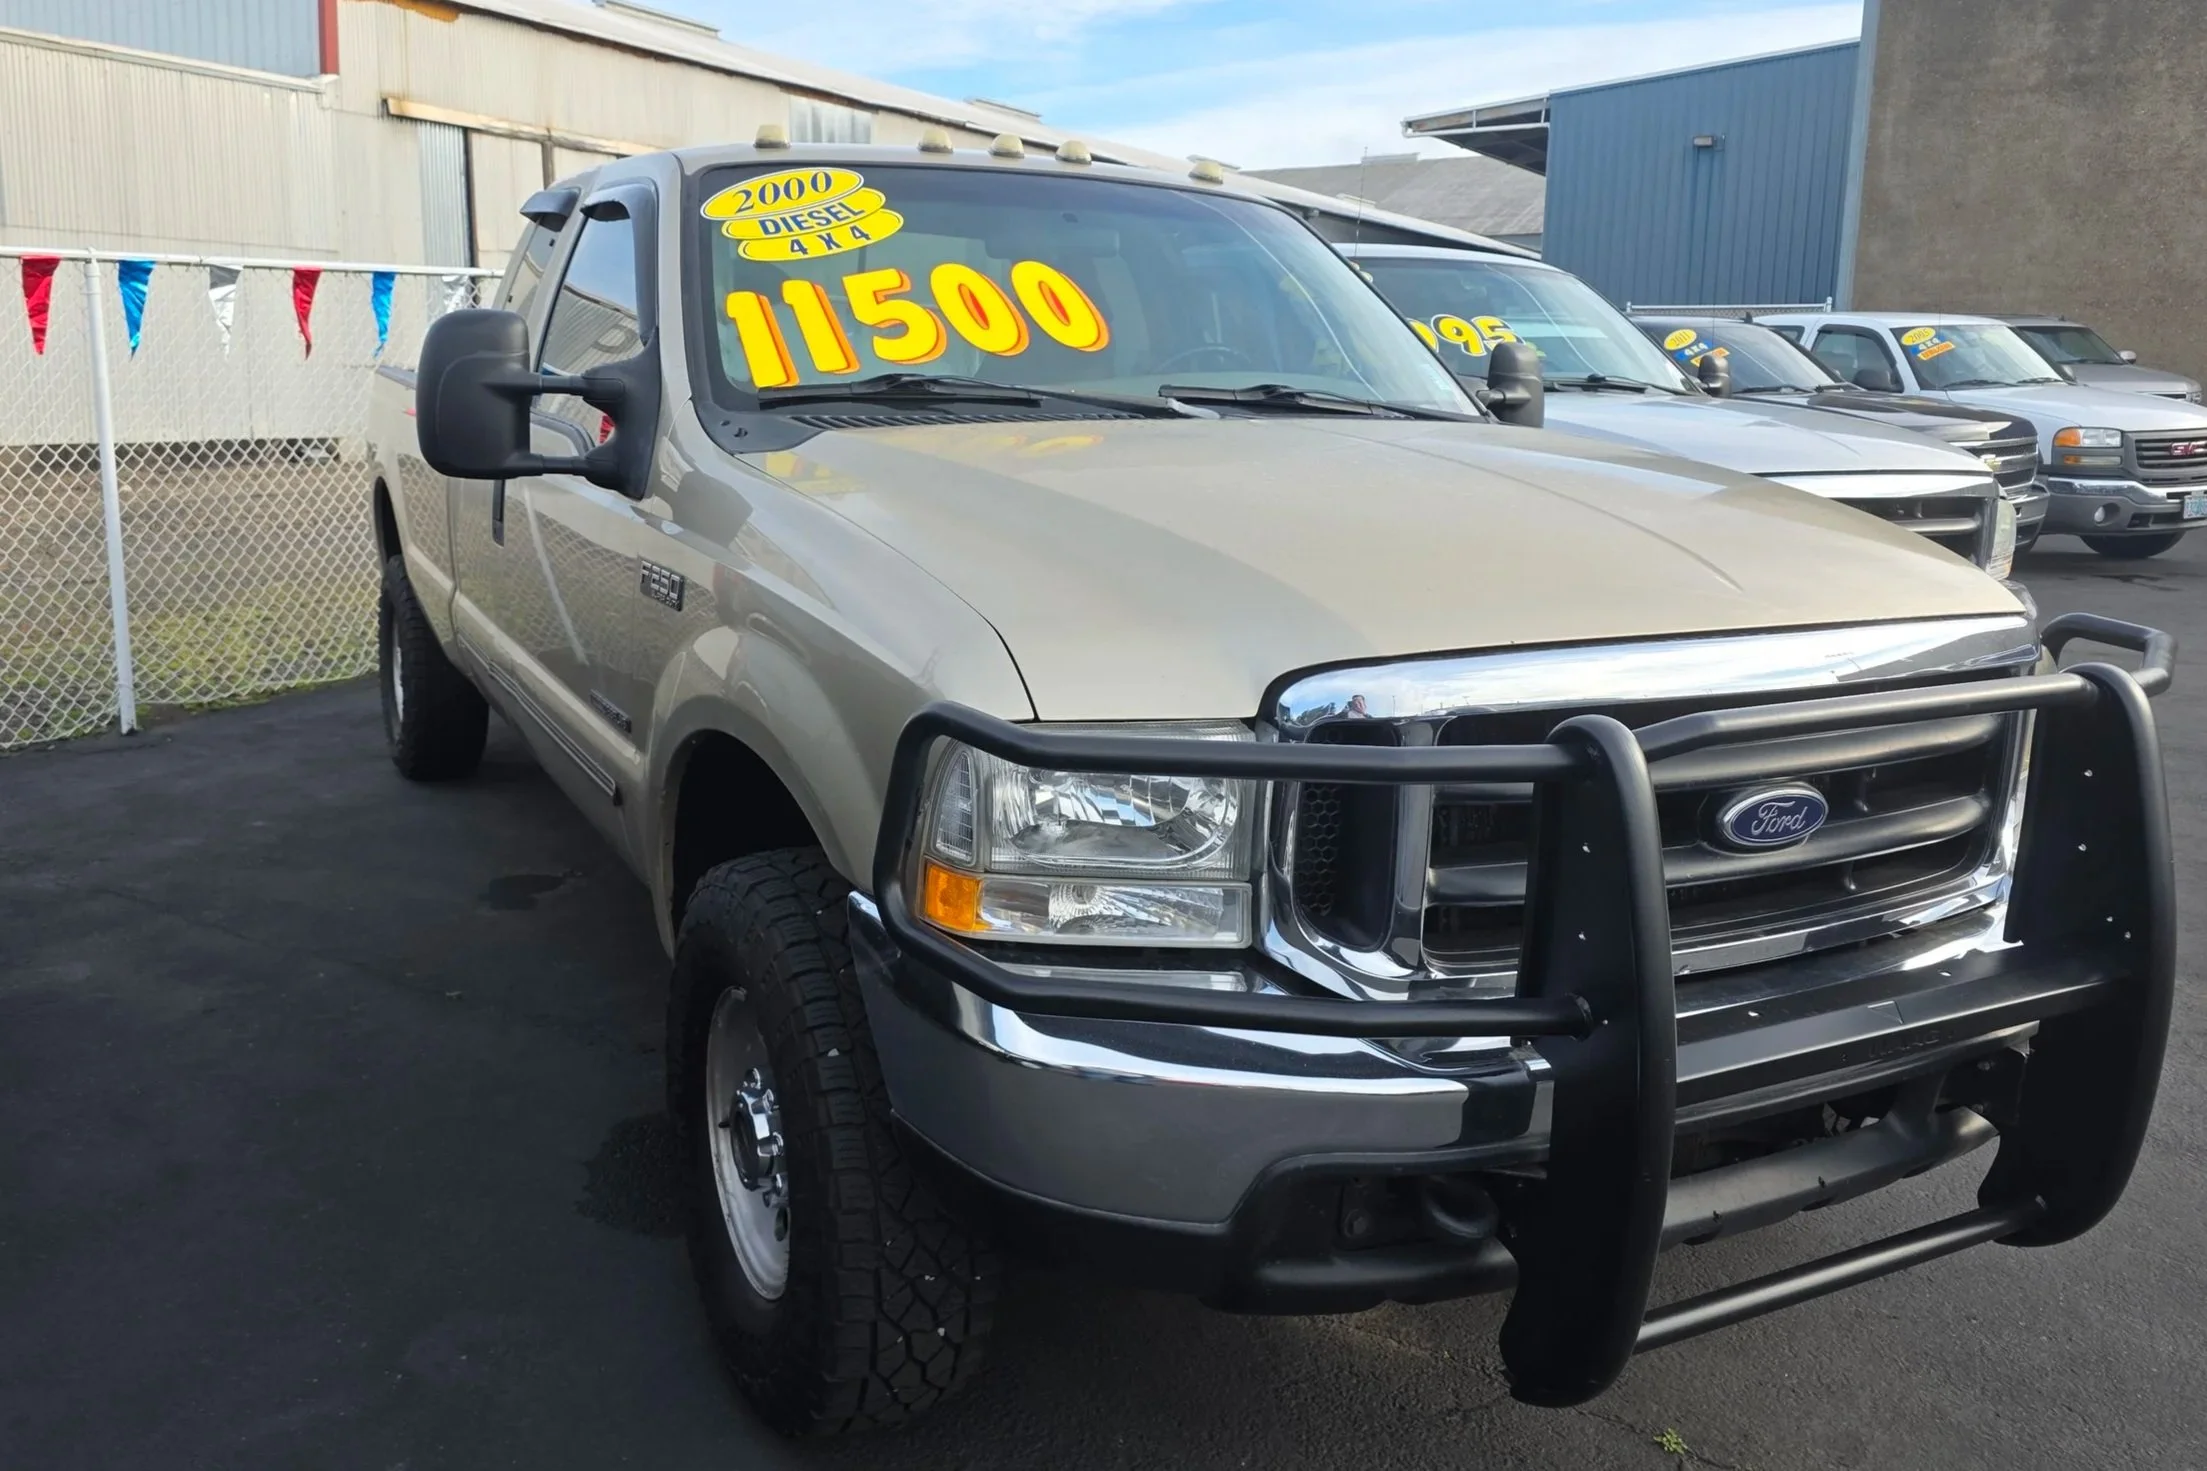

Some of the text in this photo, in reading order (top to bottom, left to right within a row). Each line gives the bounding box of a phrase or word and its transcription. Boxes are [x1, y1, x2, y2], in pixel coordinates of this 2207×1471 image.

[733, 171, 832, 214] 2000
[759, 202, 865, 236] DIESEL
[726, 261, 1110, 388] 11500
[640, 560, 681, 600] F250
[1751, 800, 1808, 836] Ford
